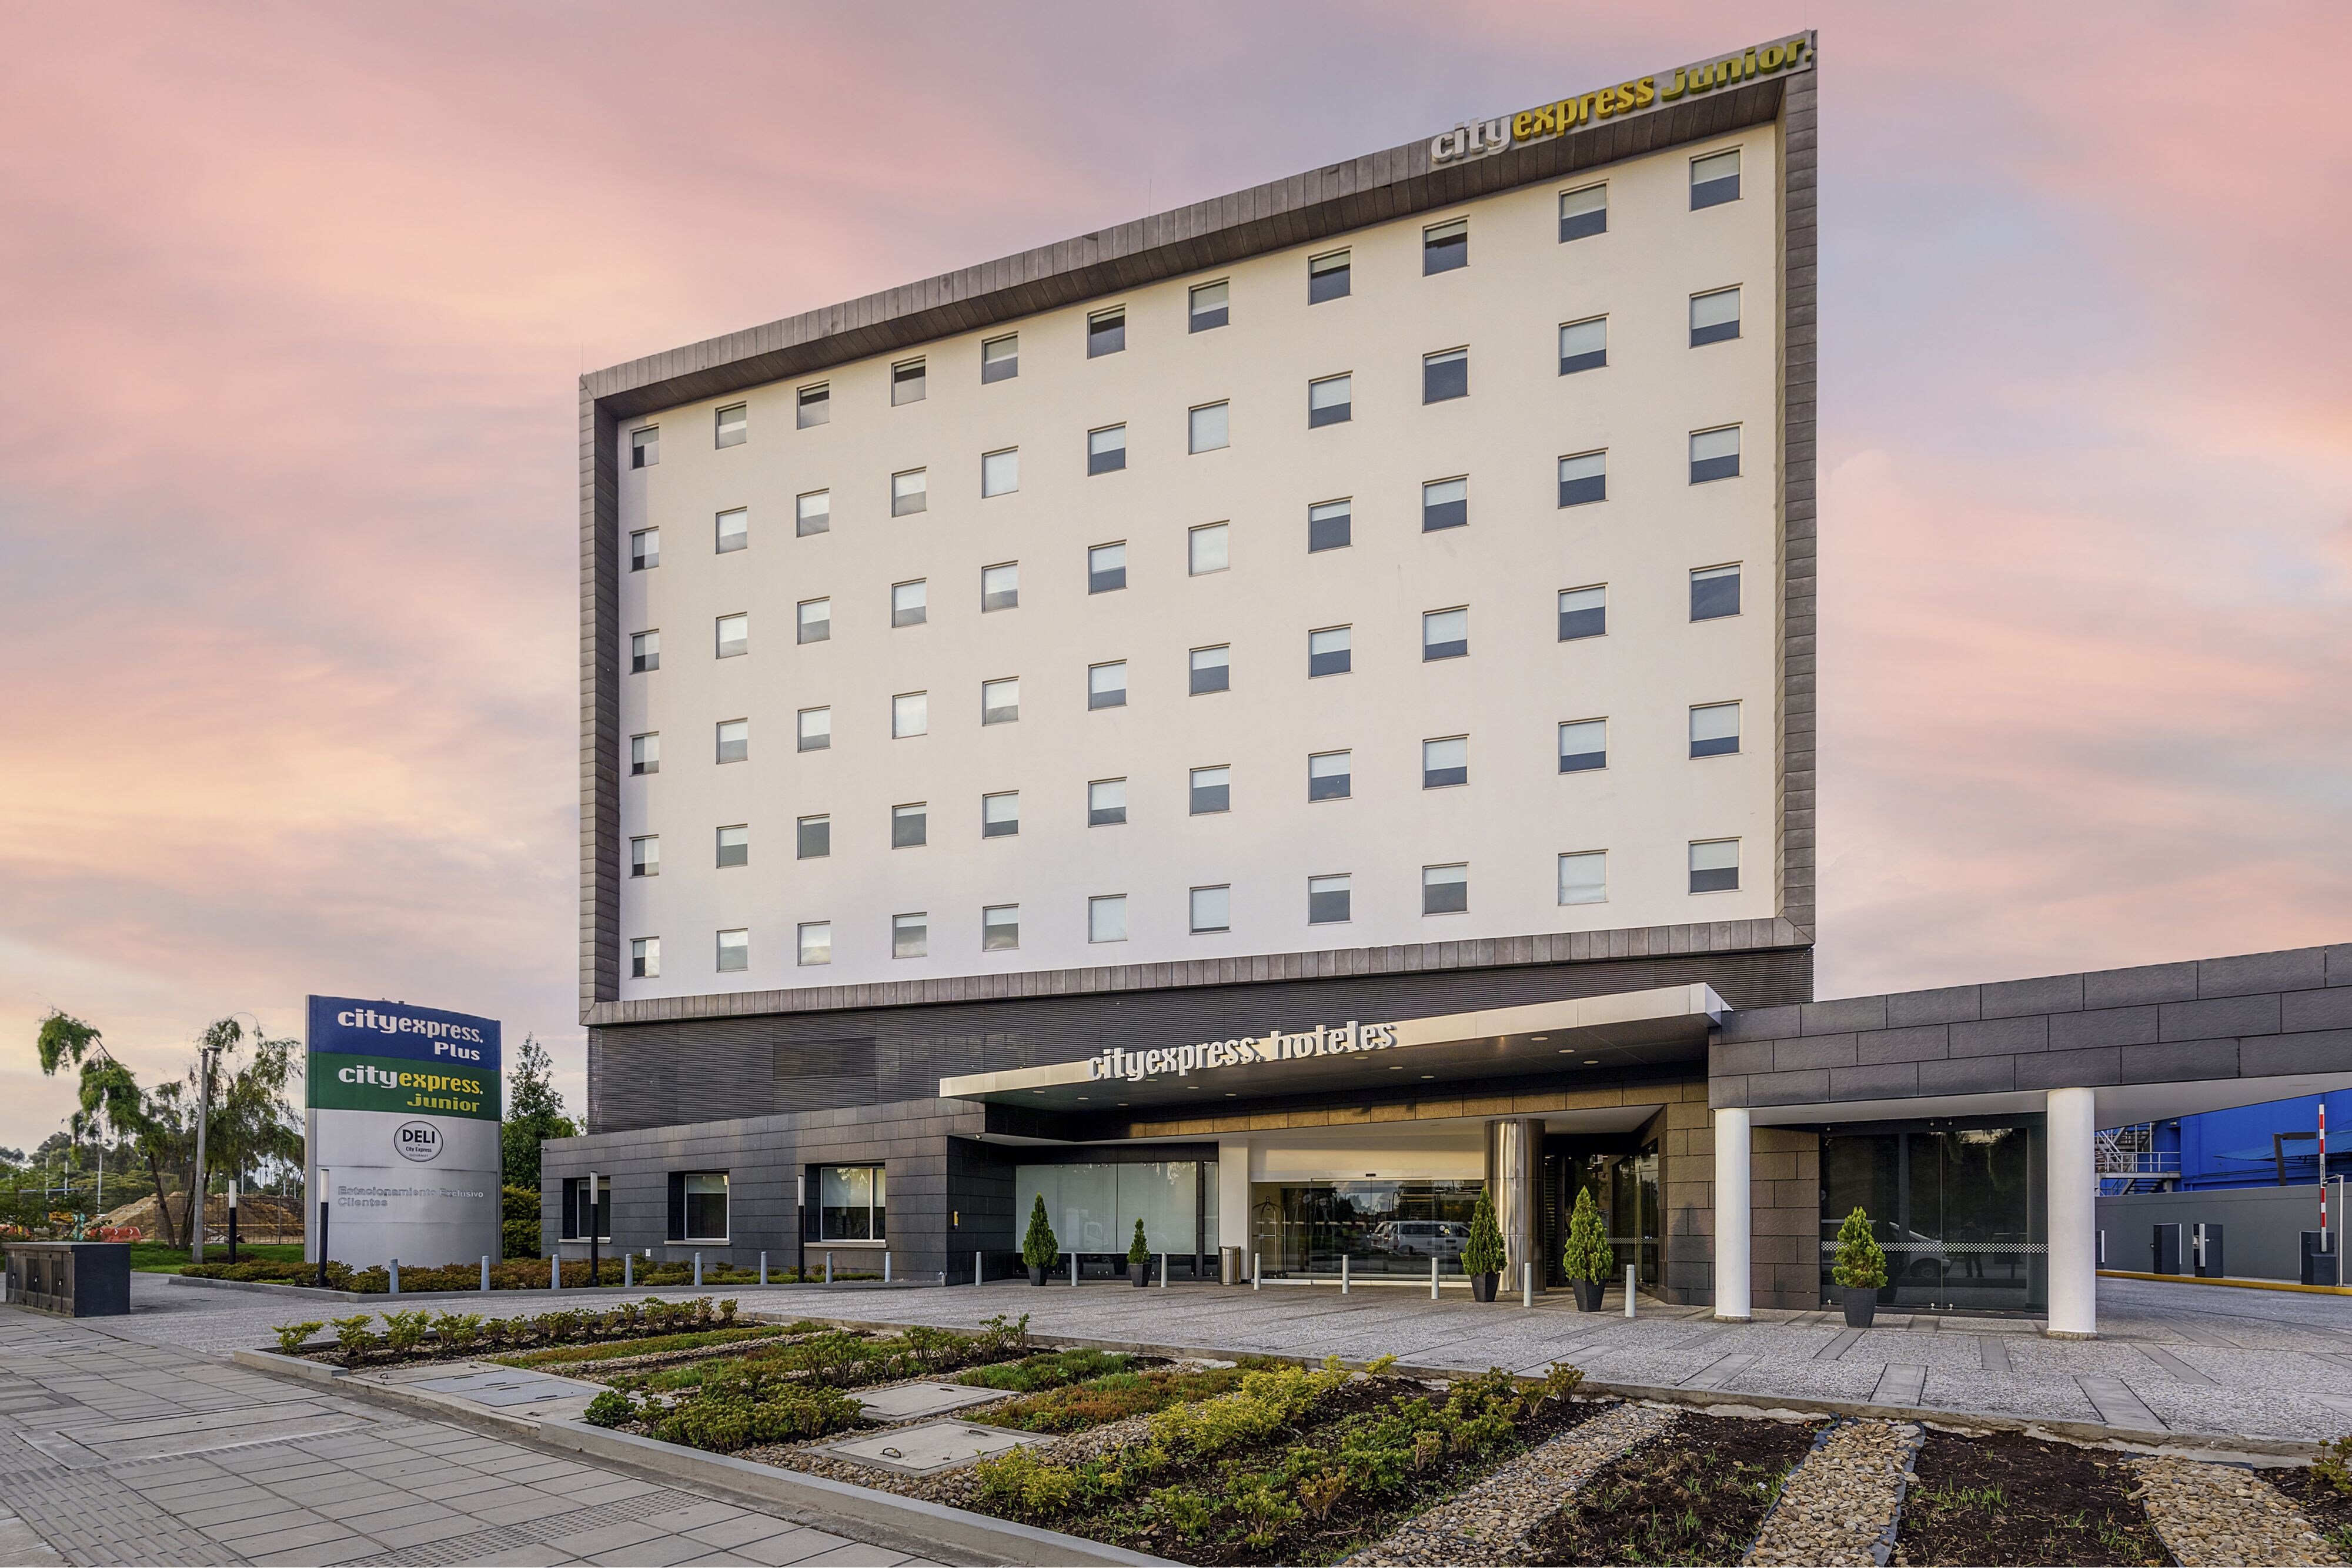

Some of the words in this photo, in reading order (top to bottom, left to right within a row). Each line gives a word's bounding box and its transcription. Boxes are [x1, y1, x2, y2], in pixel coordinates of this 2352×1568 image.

[1270, 1021, 1394, 1059] hoteles
[435, 1041, 480, 1061] Plus
[407, 1094, 480, 1112] junior
[403, 1129, 435, 1144] DELI
[338, 1186, 437, 1196] Estacionamiento
[439, 1188, 483, 1198] Exclusivo
[338, 1198, 388, 1206] Clientes
